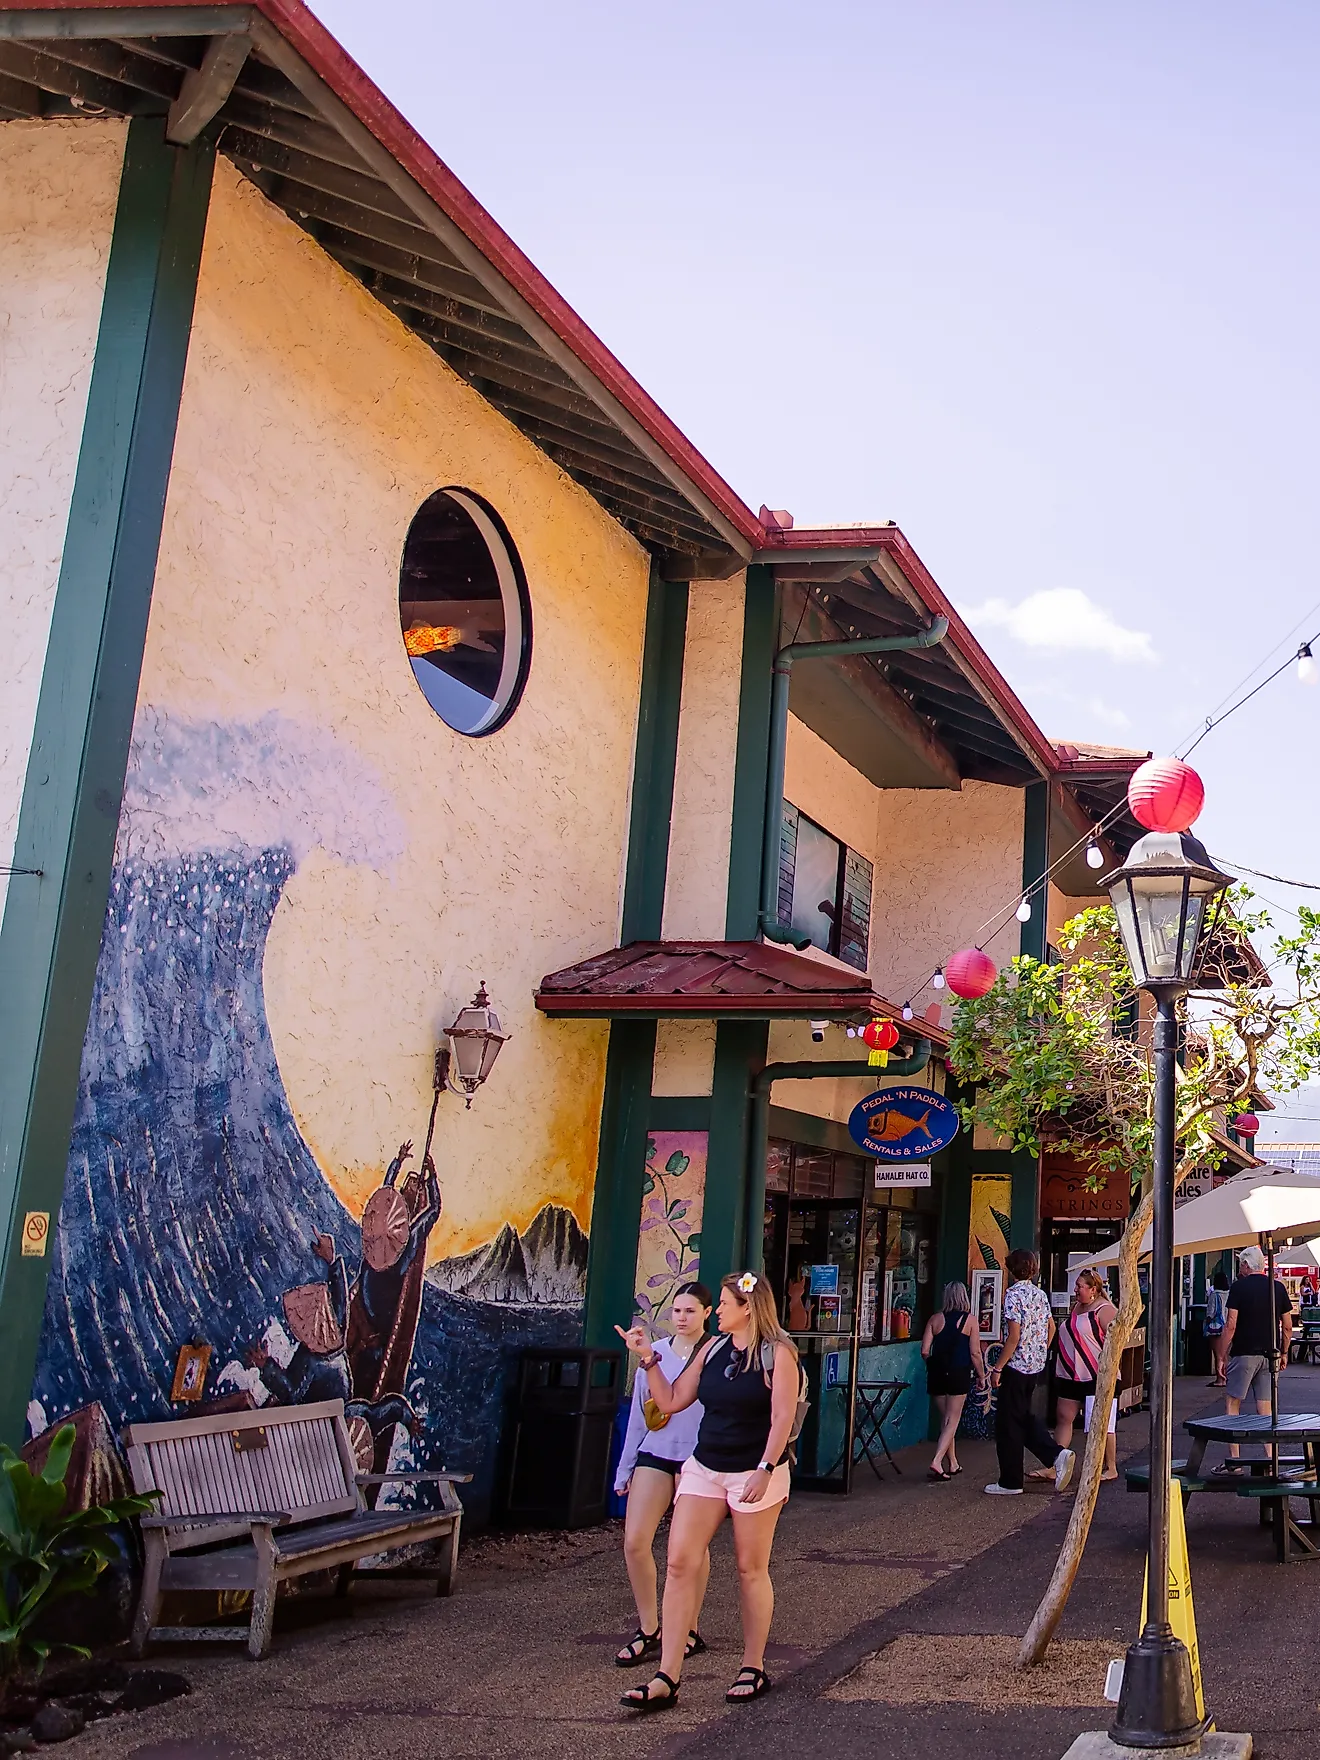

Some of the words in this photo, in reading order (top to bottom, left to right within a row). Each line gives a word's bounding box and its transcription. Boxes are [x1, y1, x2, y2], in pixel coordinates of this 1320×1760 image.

[861, 1094, 895, 1112] PEDAL
[909, 1091, 948, 1112] PADDLE
[863, 1138, 902, 1156] RENTALS
[903, 1147, 911, 1156] &
[915, 1137, 944, 1154] SALES
[876, 1171, 904, 1181] HANALEI
[905, 1171, 919, 1180] HAT
[919, 1170, 930, 1180] CO.
[1045, 1199, 1124, 1212] STRINGS
